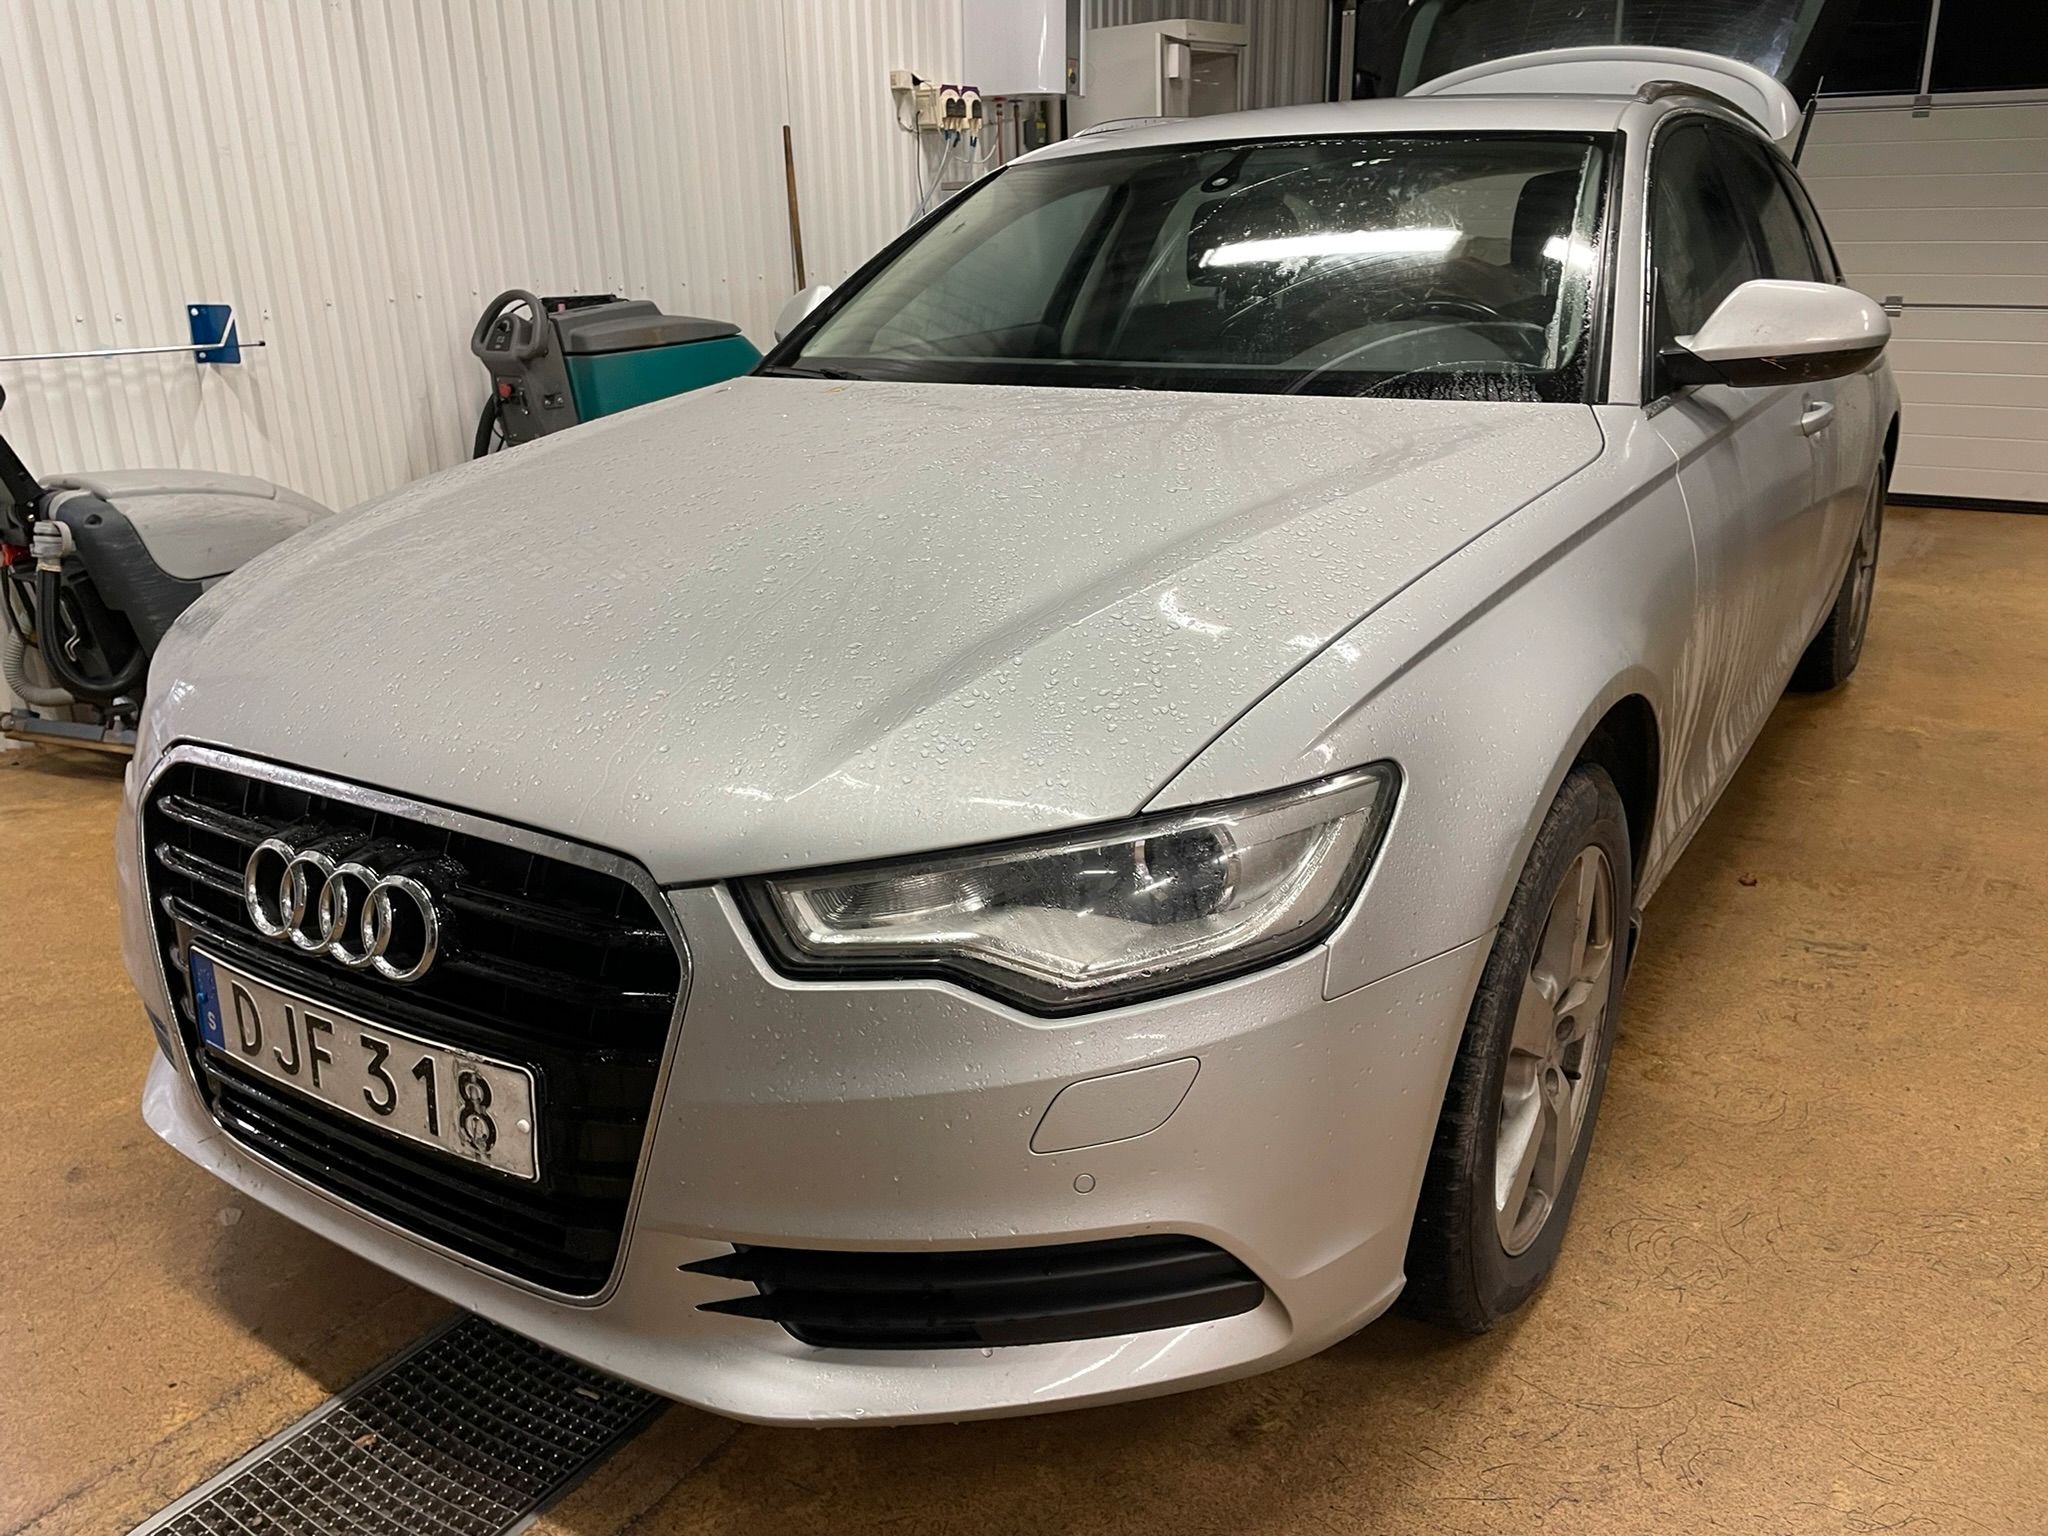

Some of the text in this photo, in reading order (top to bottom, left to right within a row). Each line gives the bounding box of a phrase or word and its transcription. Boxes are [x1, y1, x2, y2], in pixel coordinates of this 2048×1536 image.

[207, 1010, 217, 1031] S
[232, 980, 498, 1153] DJF 318
